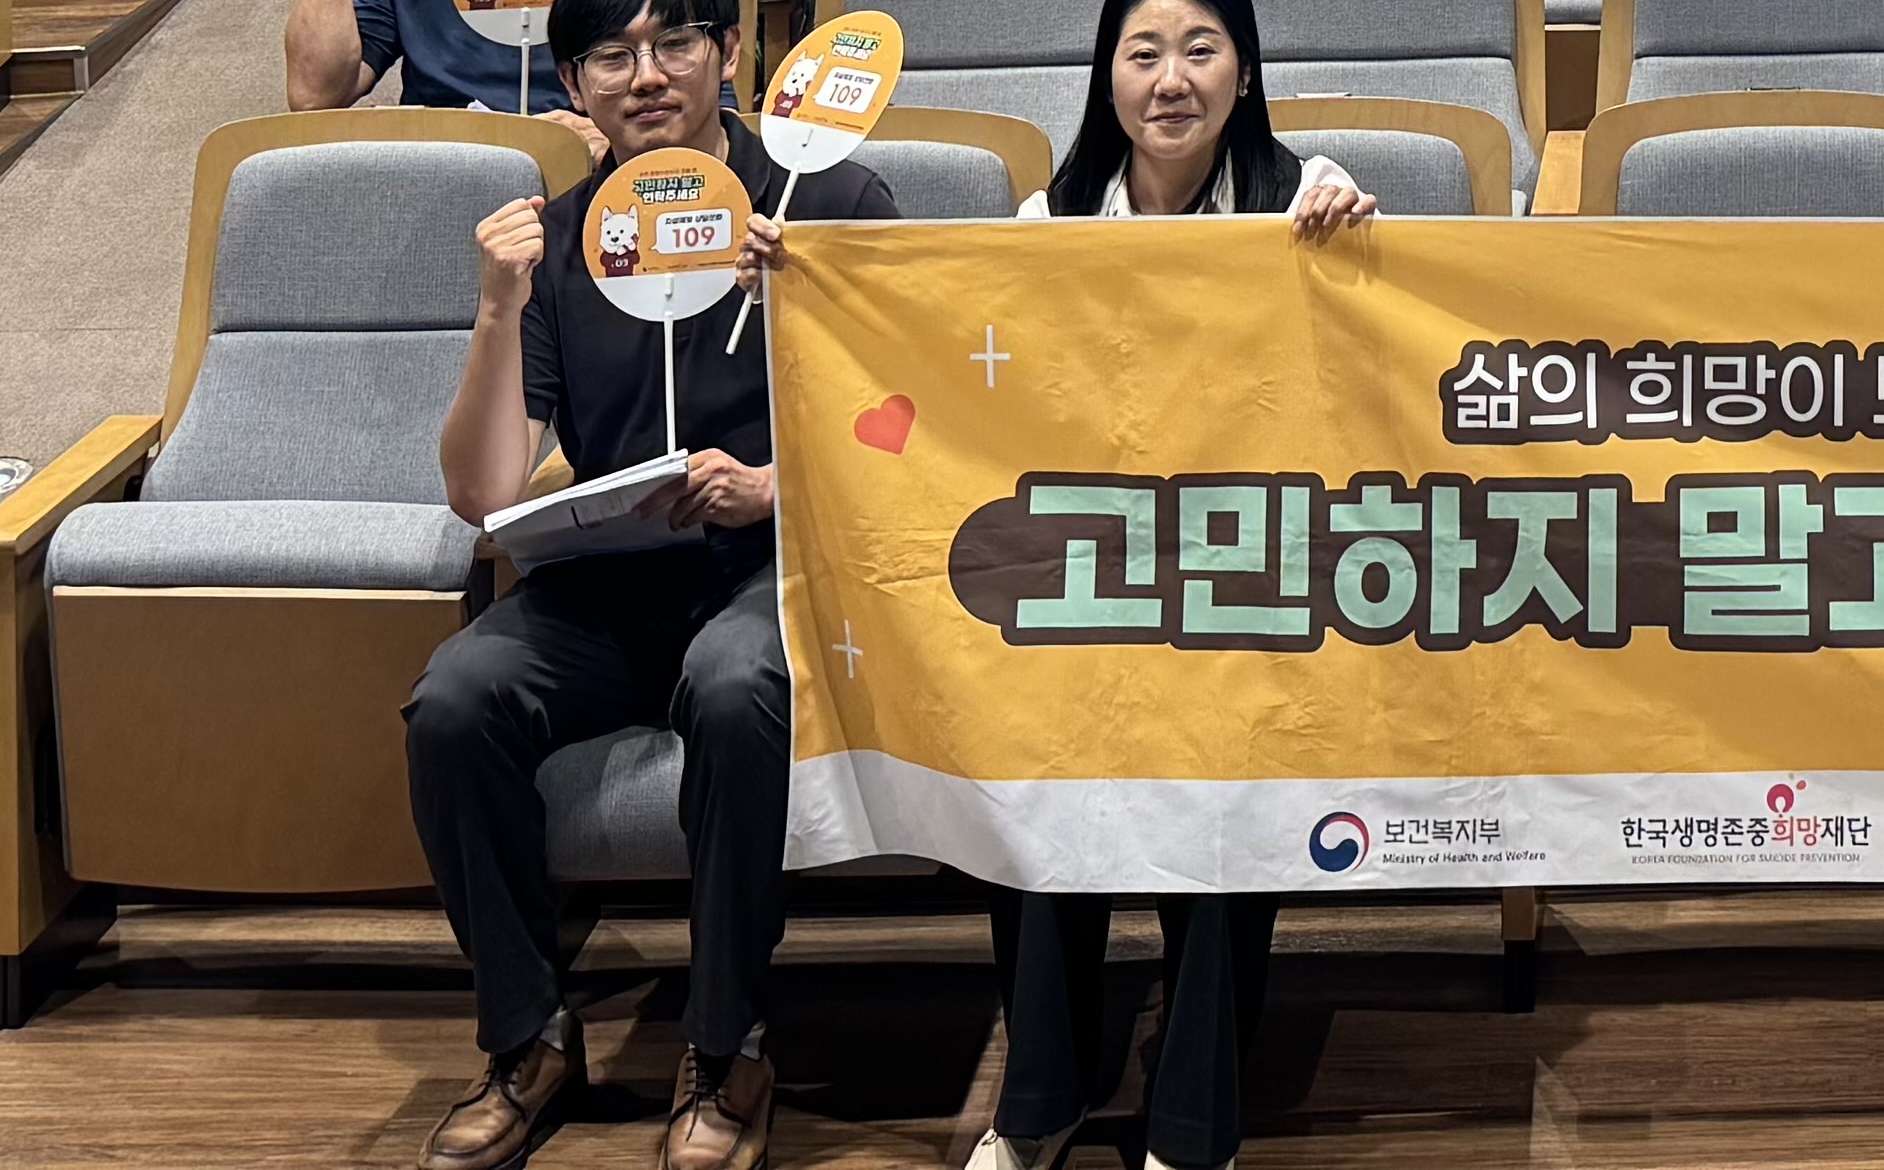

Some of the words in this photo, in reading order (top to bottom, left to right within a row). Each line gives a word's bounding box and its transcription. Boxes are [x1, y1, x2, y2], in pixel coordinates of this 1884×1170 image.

[829, 83, 862, 106] 109
[672, 226, 716, 248] 109
[1453, 351, 1598, 430] 삶의
[1625, 352, 1845, 427] 희망이
[1016, 485, 1617, 636] 고민하지
[1384, 818, 1501, 845] 보건복지부
[1620, 815, 1872, 849] 한국생명존중희망재단
[1383, 852, 1424, 865] Ministry
[1428, 852, 1440, 864] of
[1443, 851, 1478, 863] Health
[1482, 851, 1502, 863] and
[1667, 853, 1733, 864] FOUNDATION
